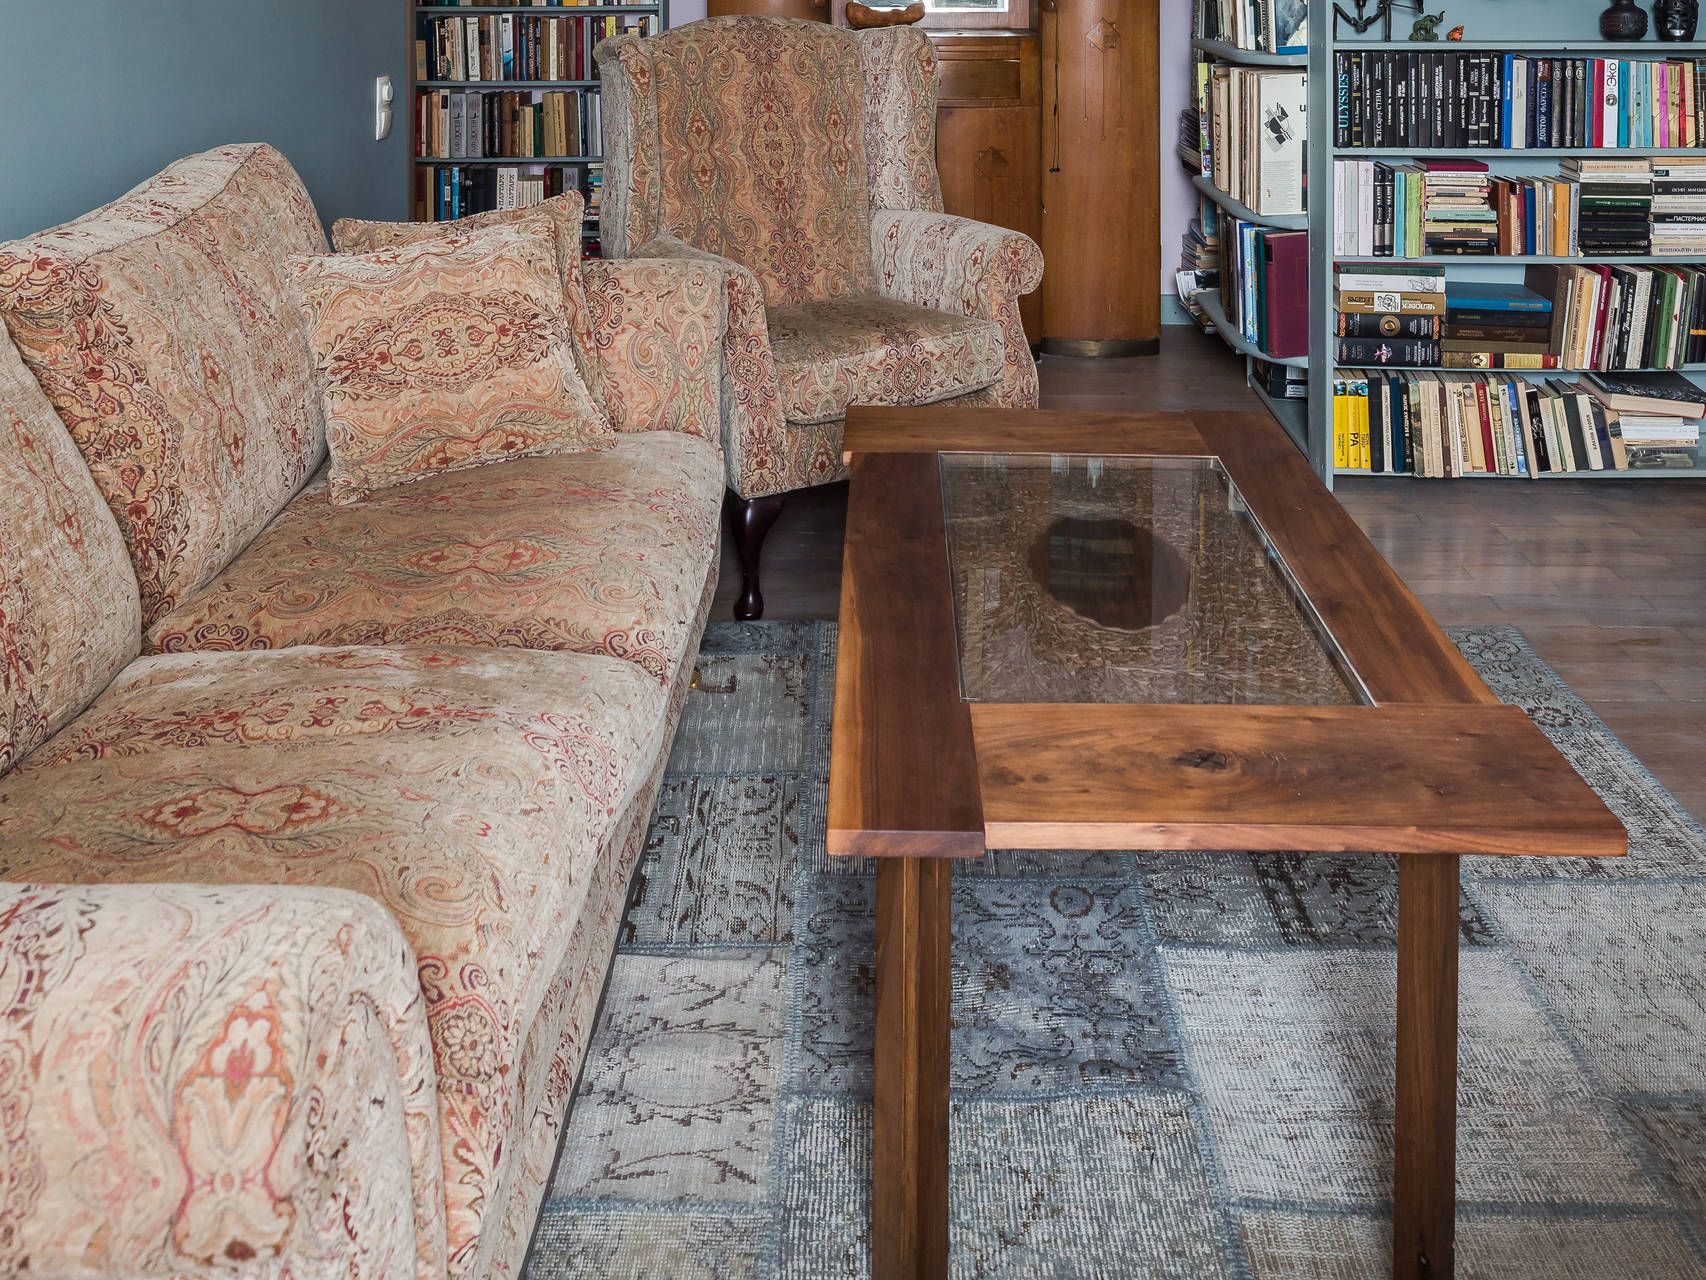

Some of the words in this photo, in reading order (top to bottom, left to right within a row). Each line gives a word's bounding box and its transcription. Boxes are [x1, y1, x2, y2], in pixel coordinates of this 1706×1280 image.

[1606, 62, 1617, 87] Эко
[1338, 73, 1349, 128] ULYSSES
[1539, 114, 1547, 142] ДОКТОР
[1350, 432, 1359, 447] РА
